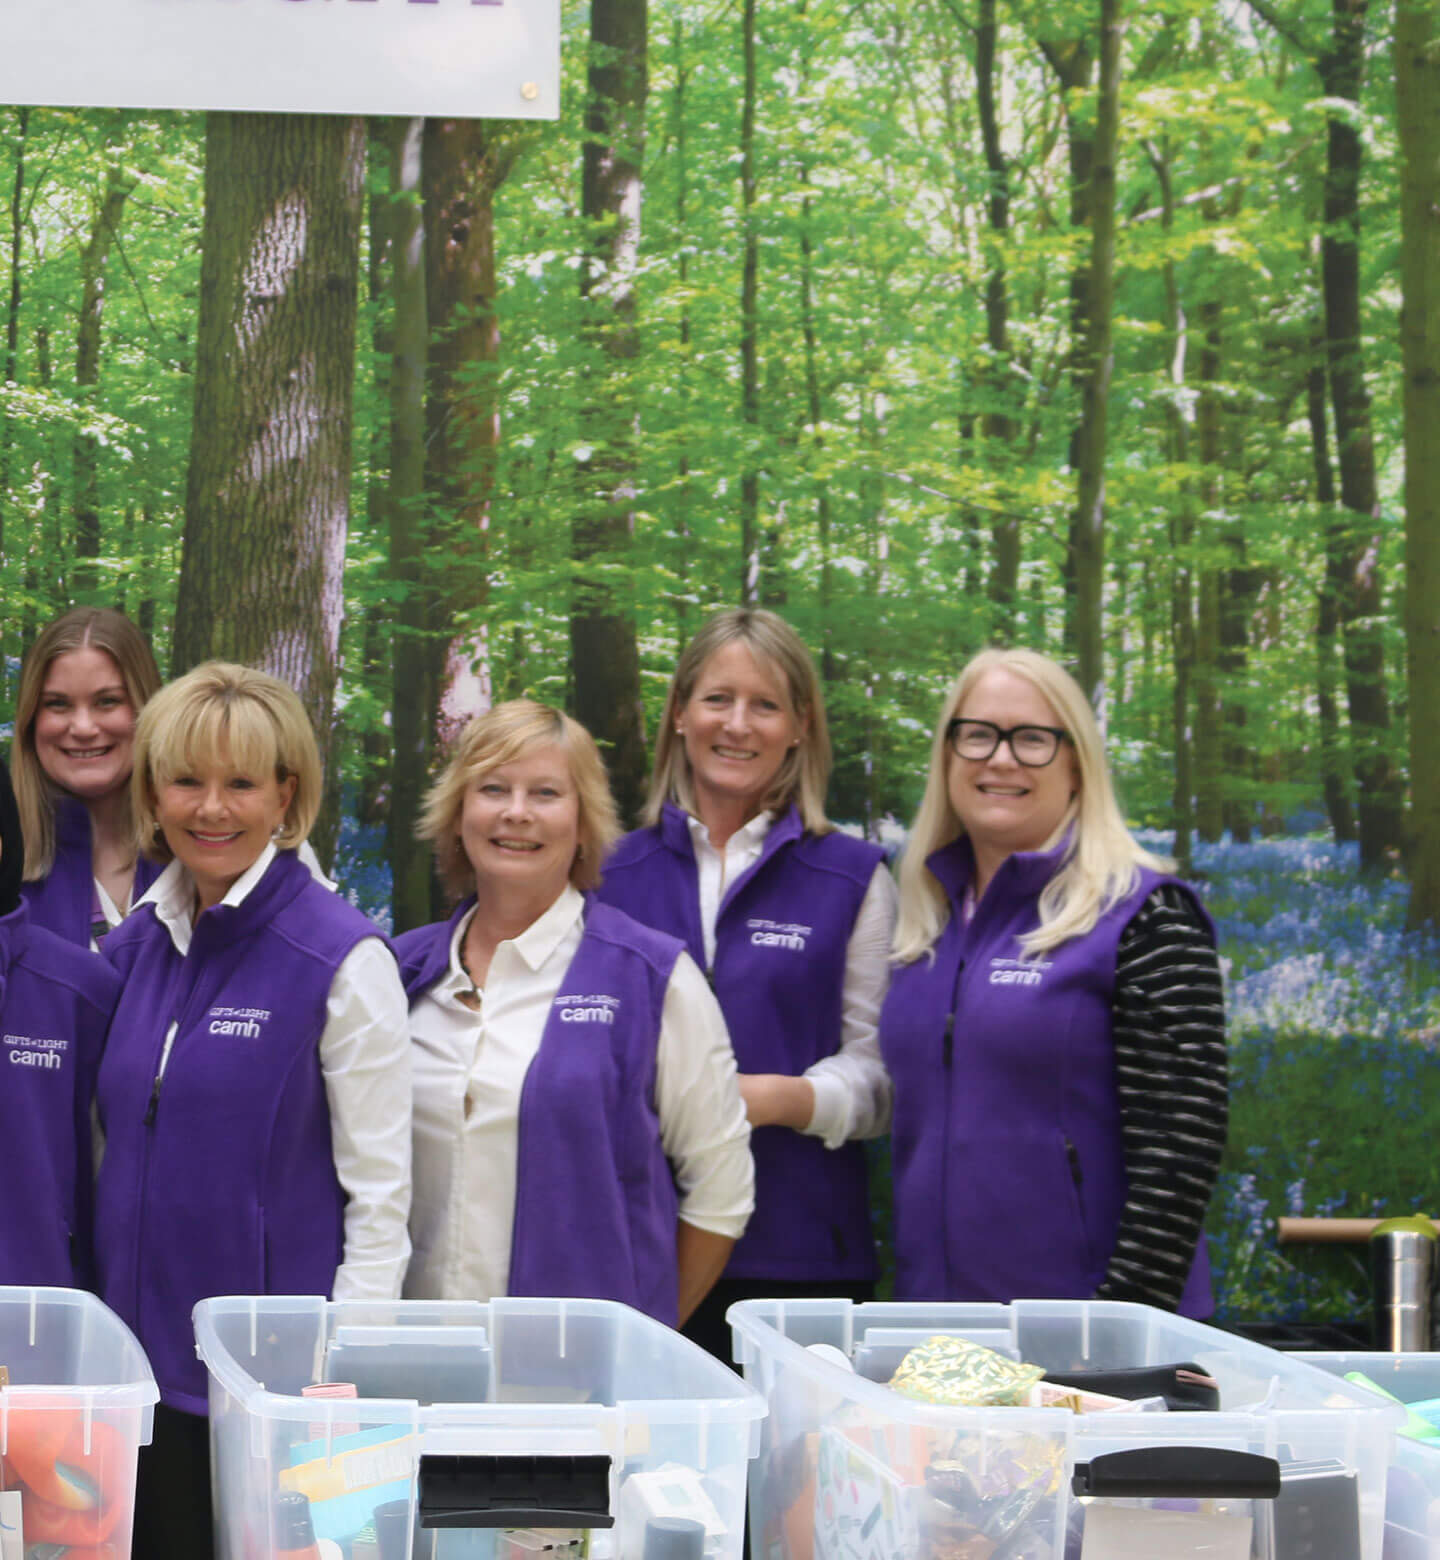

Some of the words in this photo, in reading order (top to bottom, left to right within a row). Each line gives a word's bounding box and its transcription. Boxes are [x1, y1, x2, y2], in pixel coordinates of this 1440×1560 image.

[751, 931, 805, 951] camh
[989, 968, 1042, 985] camh
[560, 1004, 614, 1024] camh
[209, 1018, 260, 1039] camh
[9, 1049, 61, 1069] camh
